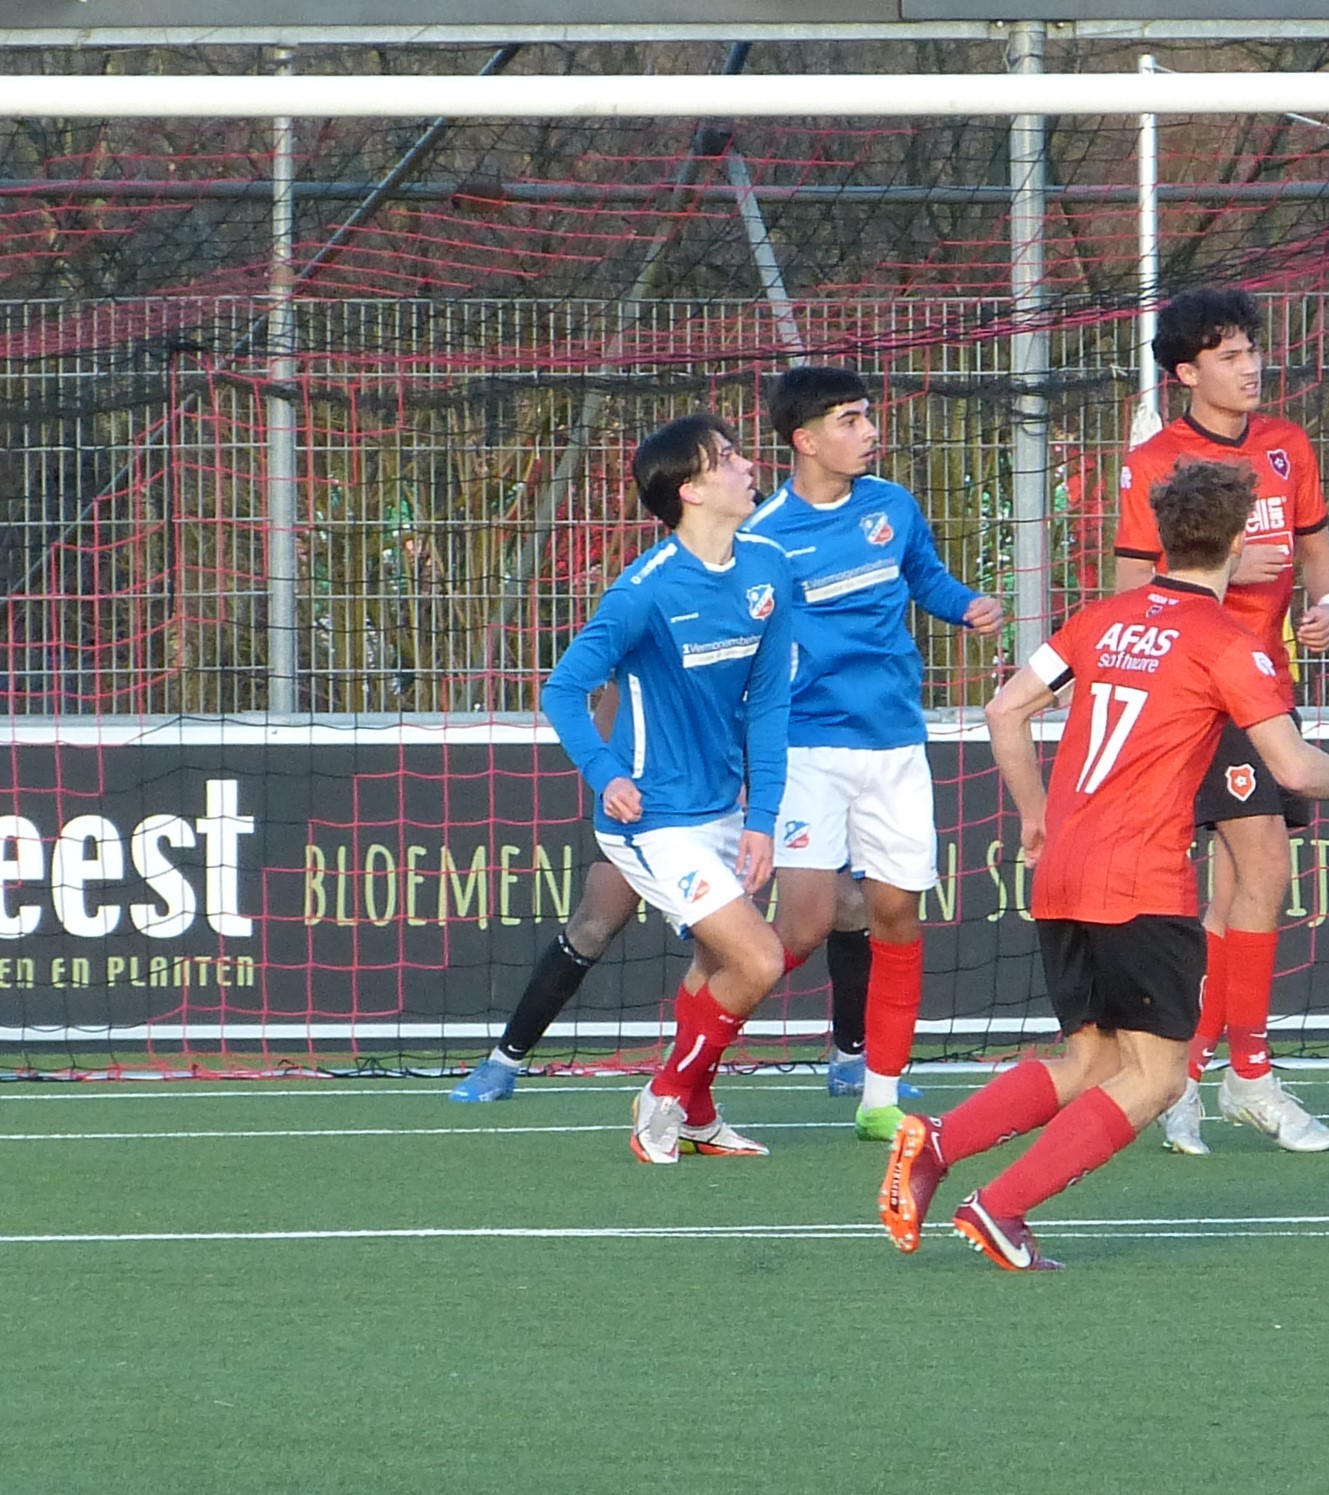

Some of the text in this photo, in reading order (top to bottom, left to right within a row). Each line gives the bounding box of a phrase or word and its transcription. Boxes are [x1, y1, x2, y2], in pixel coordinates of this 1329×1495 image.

[1095, 622, 1180, 656] AFAS
[1097, 651, 1160, 673] software
[1075, 682, 1149, 794] 17
[0, 779, 254, 939] eest
[304, 843, 572, 930] BLOEMEN
[52, 958, 90, 988] EN
[107, 956, 254, 988] PLANTEN
